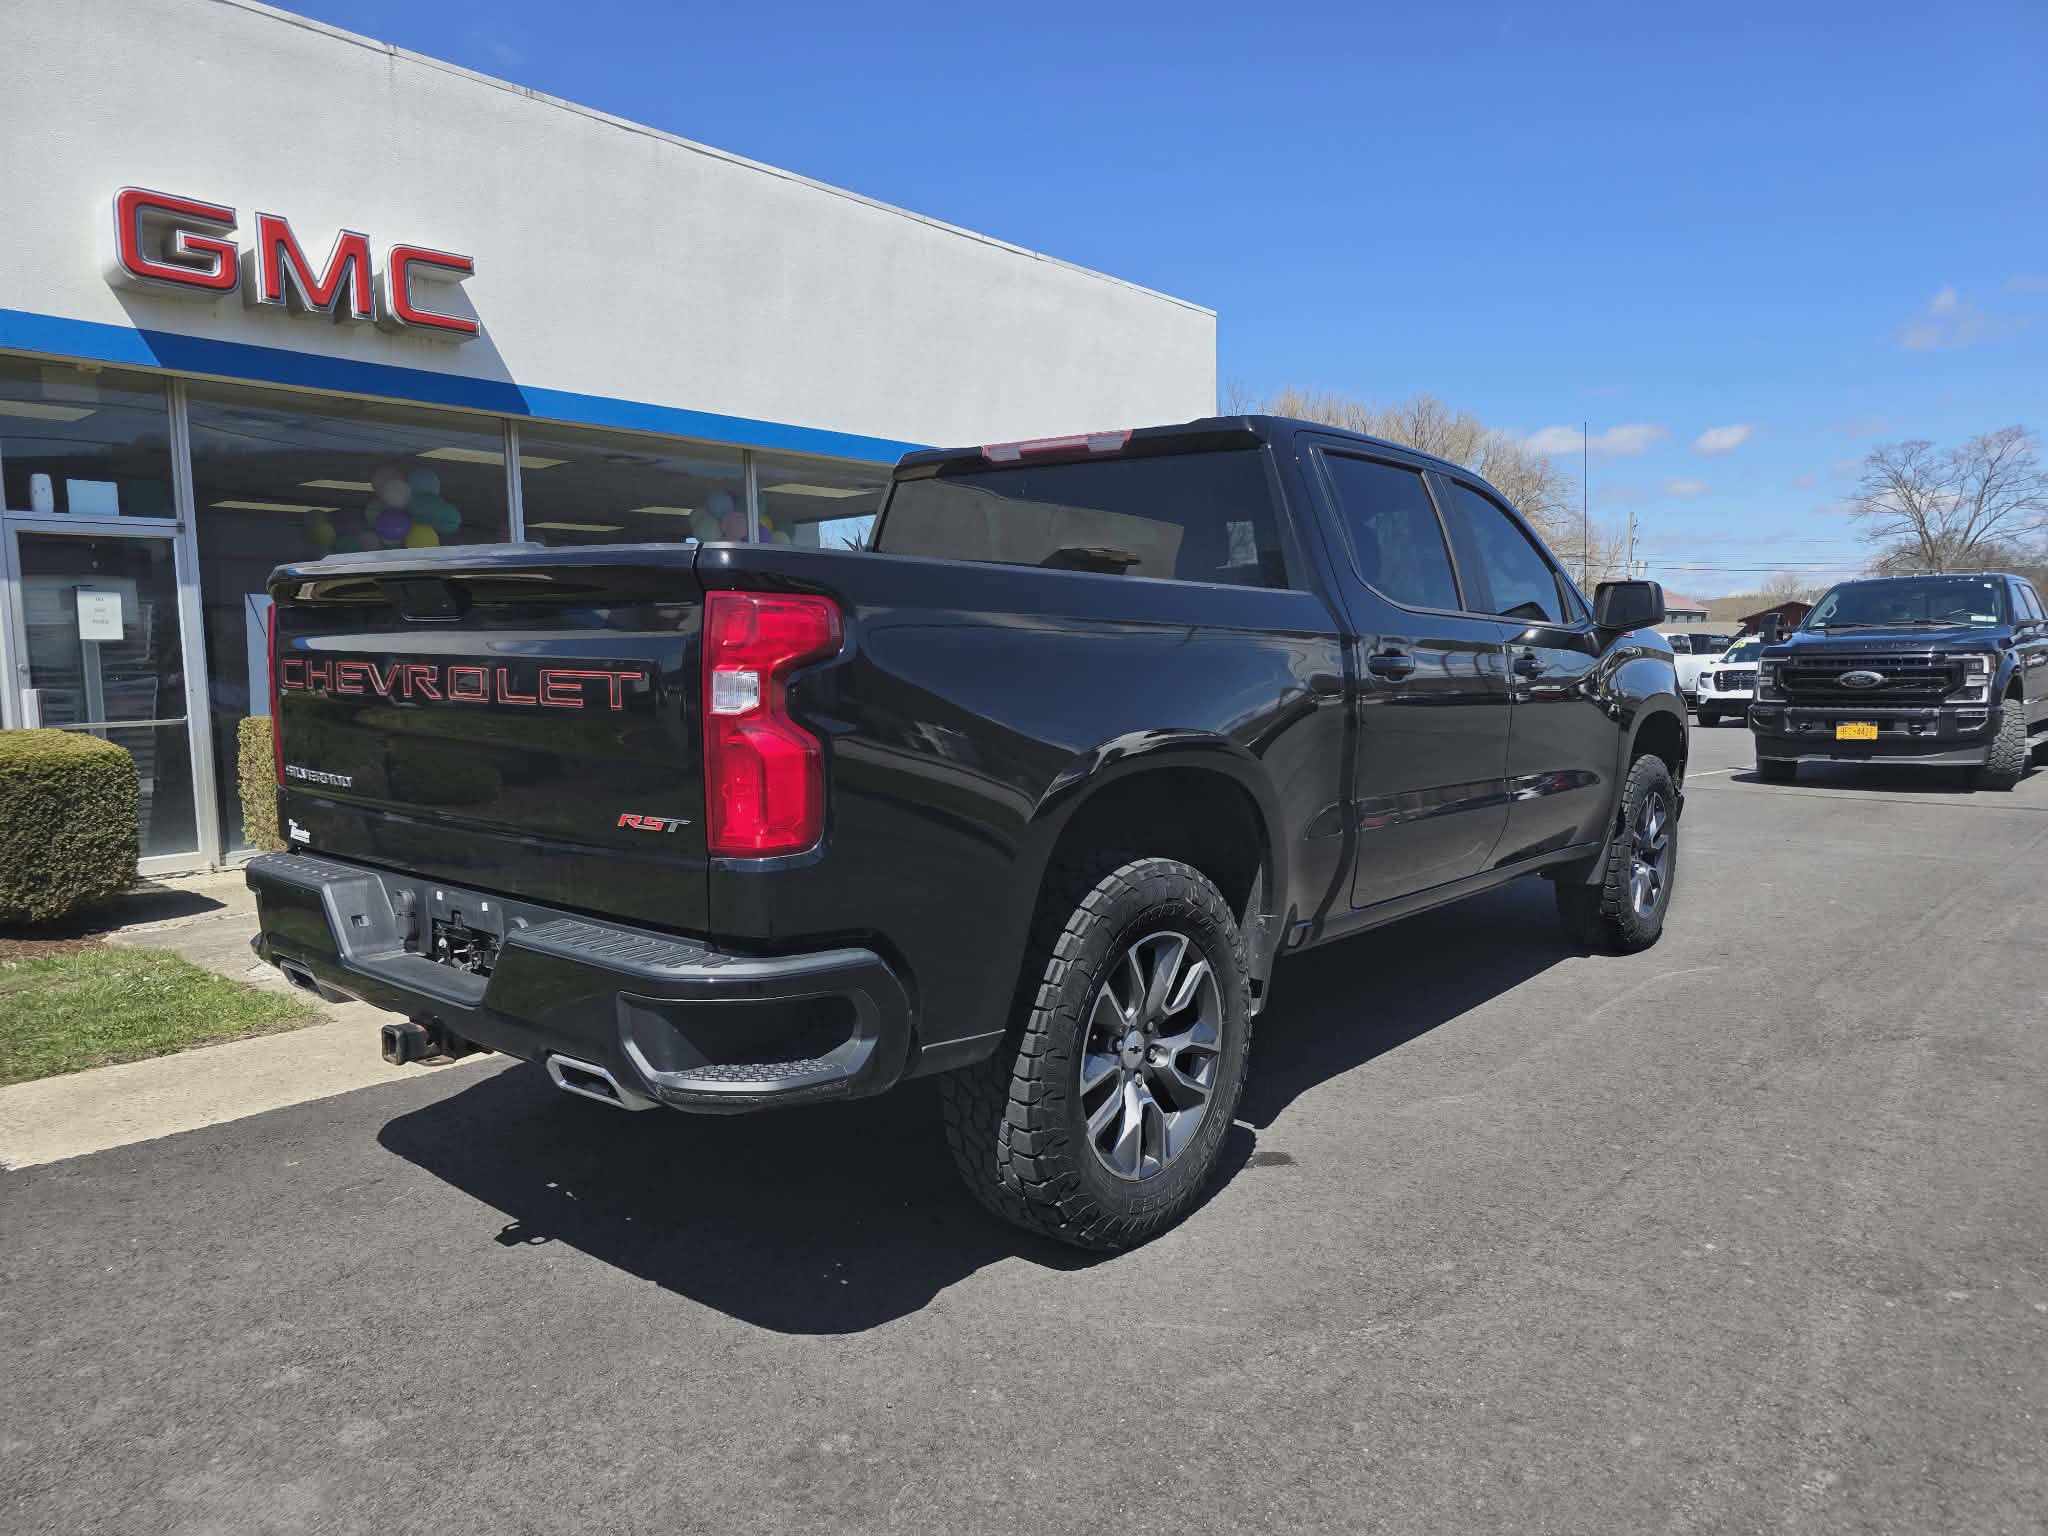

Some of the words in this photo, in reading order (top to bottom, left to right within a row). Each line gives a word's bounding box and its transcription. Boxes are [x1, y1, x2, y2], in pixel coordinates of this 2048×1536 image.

[112, 185, 481, 337] GMC
[281, 659, 643, 710] CHEVROLET
[617, 813, 691, 833] RST
